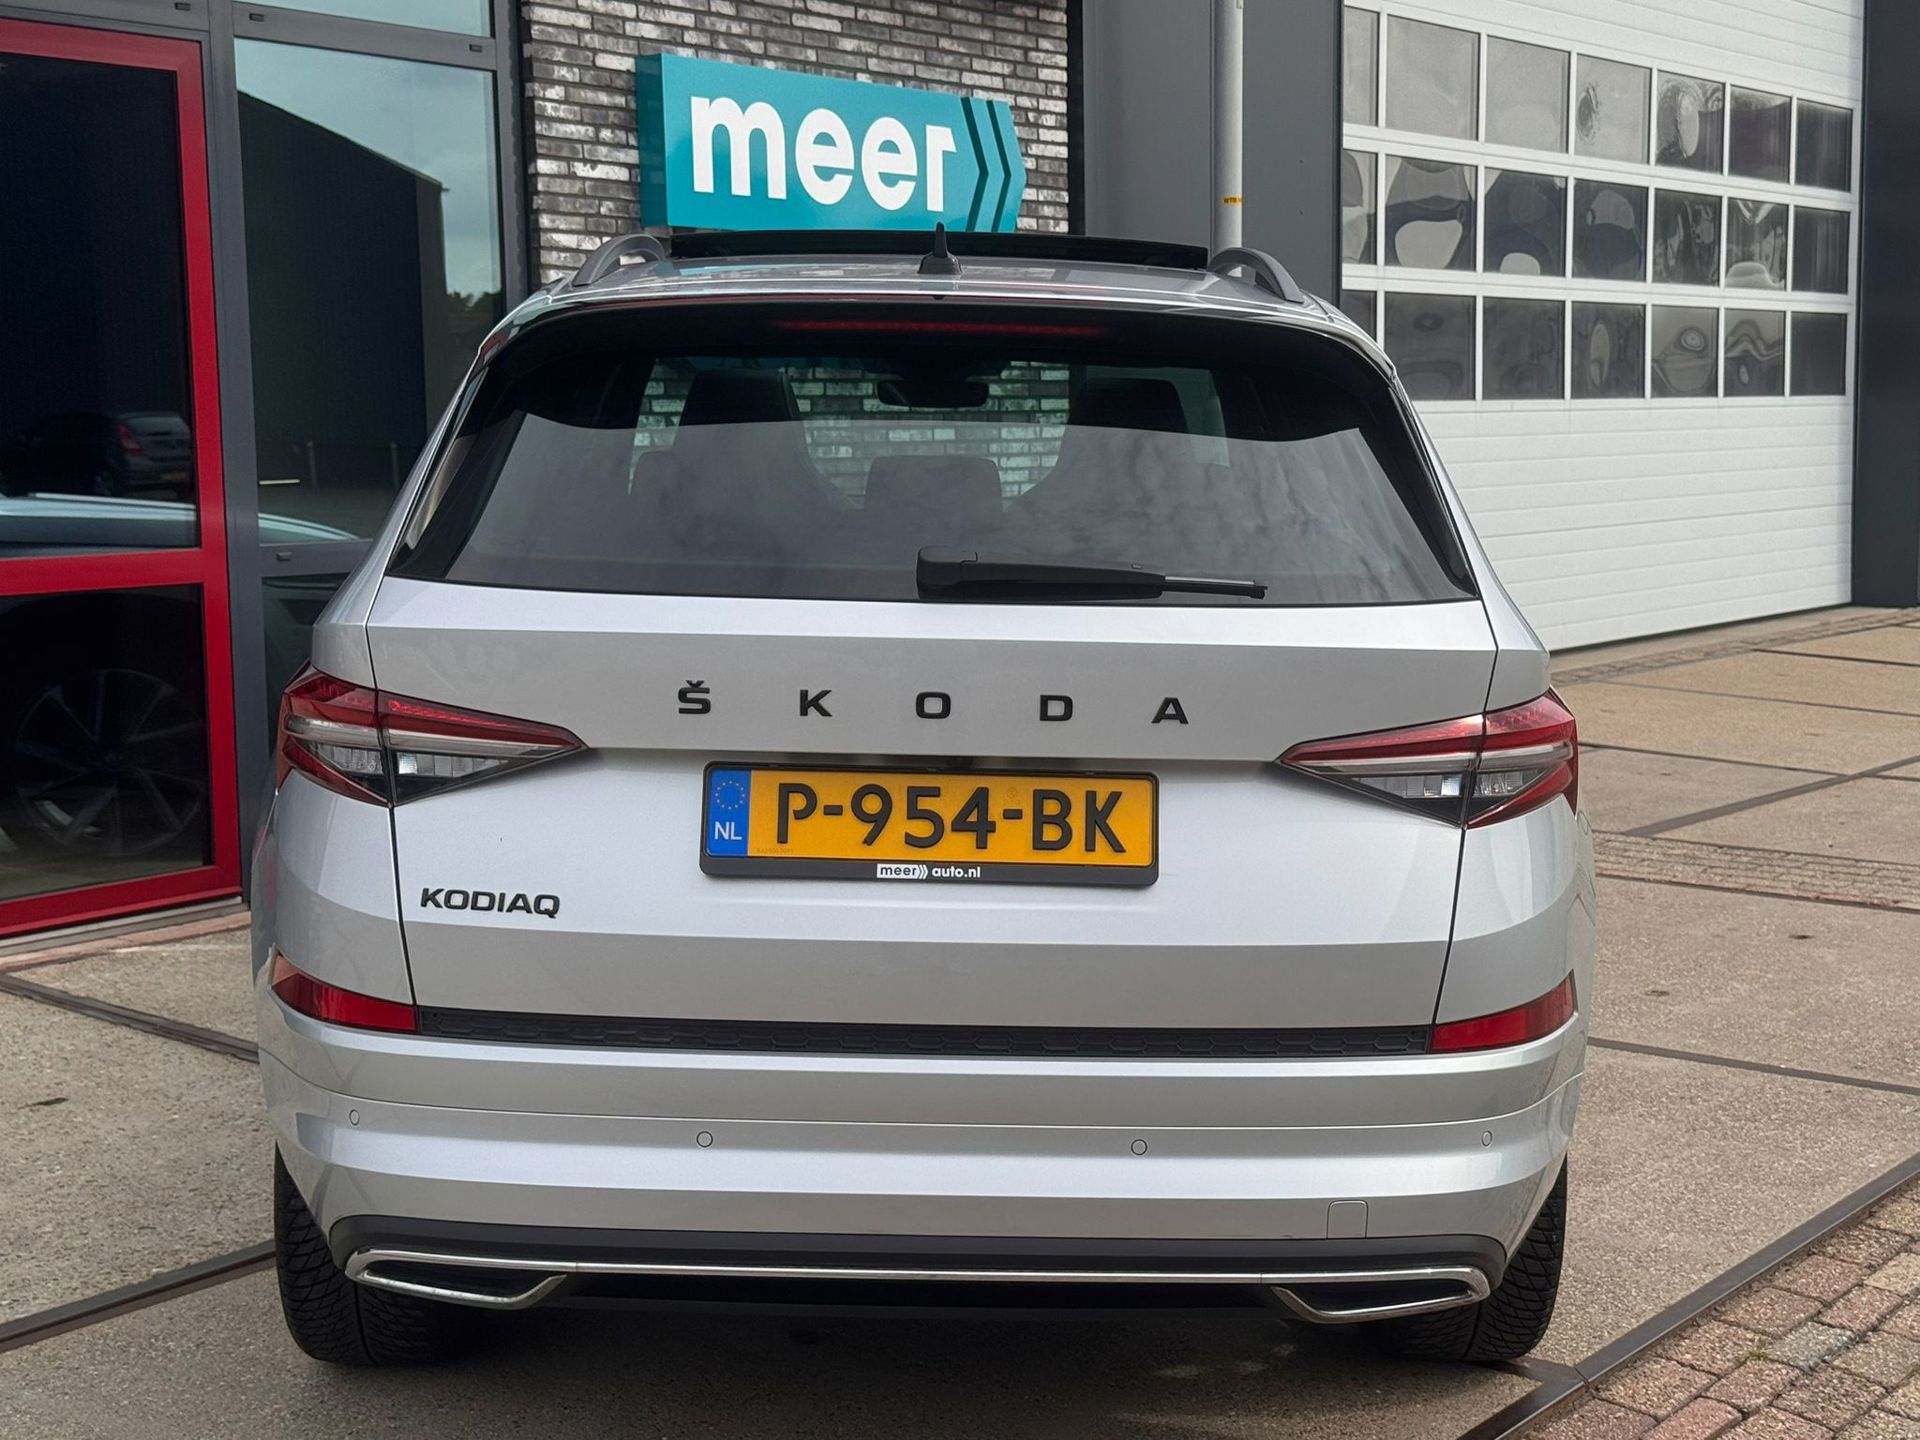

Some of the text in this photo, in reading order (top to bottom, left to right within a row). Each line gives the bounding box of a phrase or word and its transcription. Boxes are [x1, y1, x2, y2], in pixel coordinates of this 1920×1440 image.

[690, 95, 957, 212] meer
[677, 679, 1189, 725] ŠKODA
[714, 821, 742, 841] NL
[777, 782, 1127, 853] P-954-BK
[880, 866, 981, 878] meer auto.nl
[420, 887, 561, 919] KODIAQ
